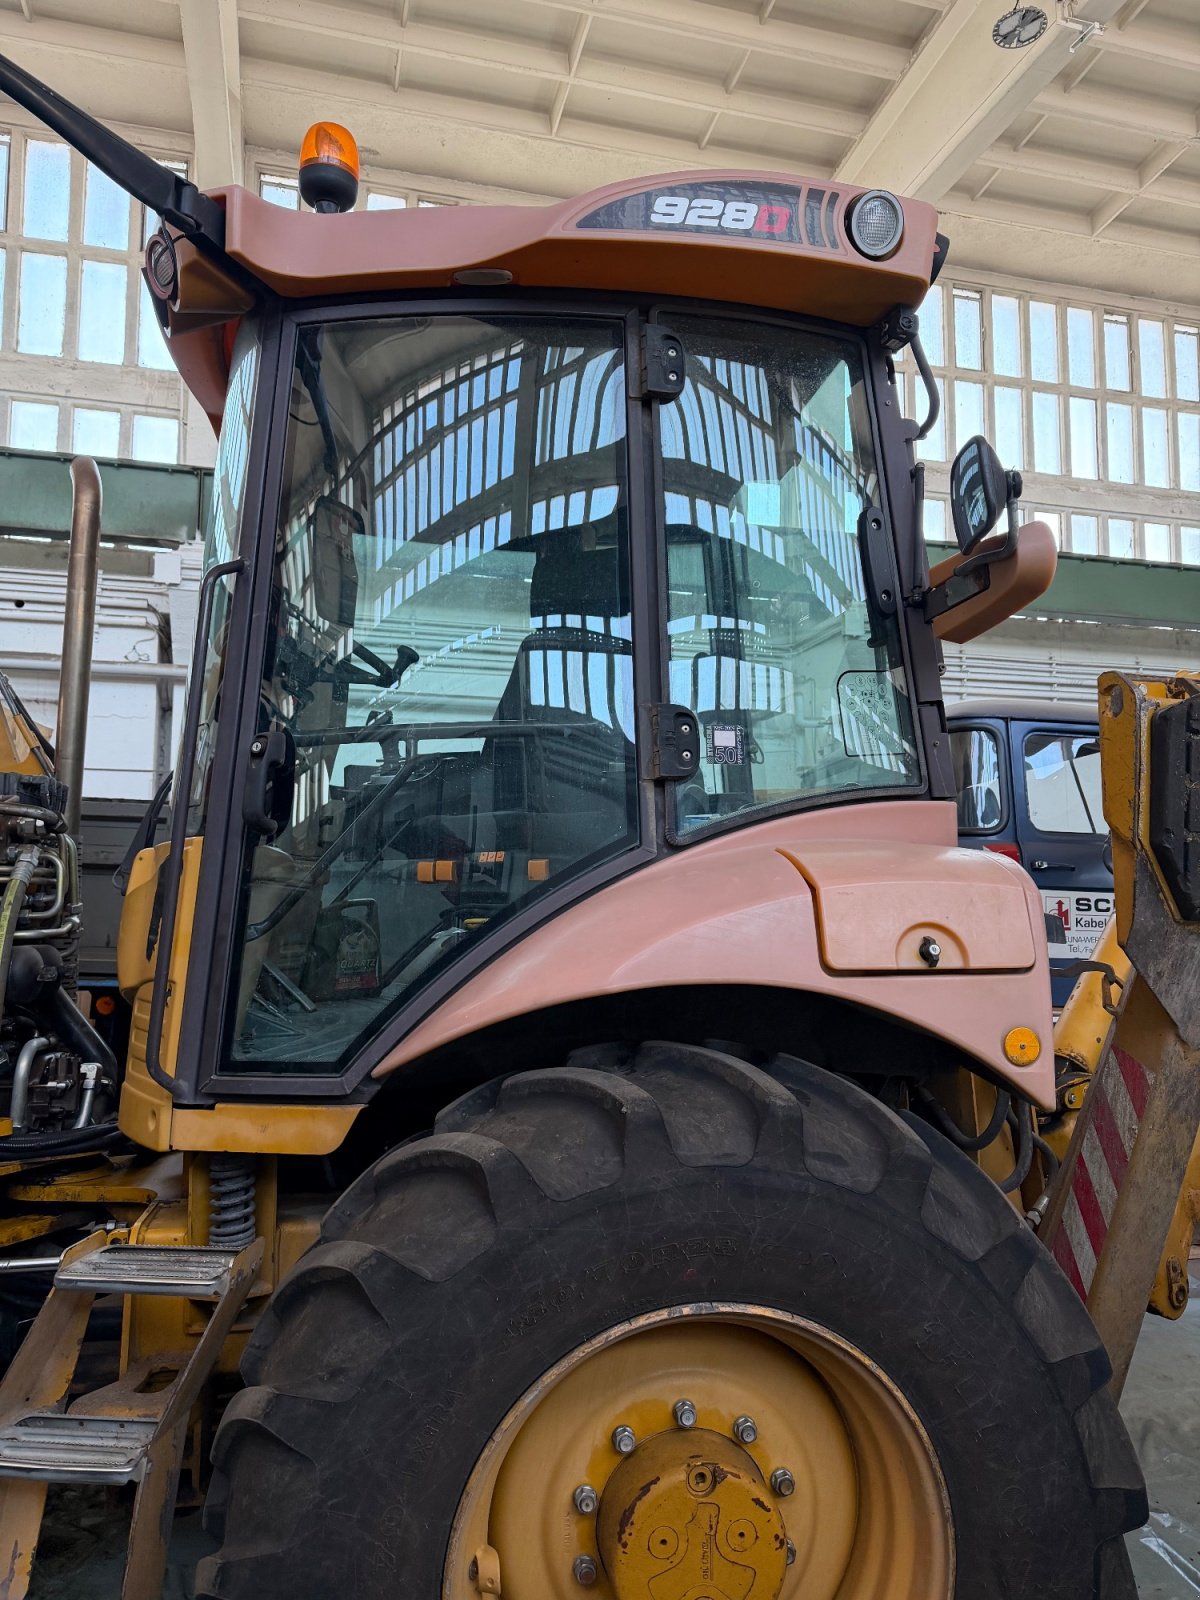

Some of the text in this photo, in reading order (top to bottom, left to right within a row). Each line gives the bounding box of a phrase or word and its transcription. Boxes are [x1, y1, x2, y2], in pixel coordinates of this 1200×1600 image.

[650, 195, 791, 234] 928D
[706, 725, 714, 757] HYDREMA
[714, 746, 737, 765] 50
[1075, 897, 1116, 913] SC
[1066, 936, 1100, 944] UNA-WE
